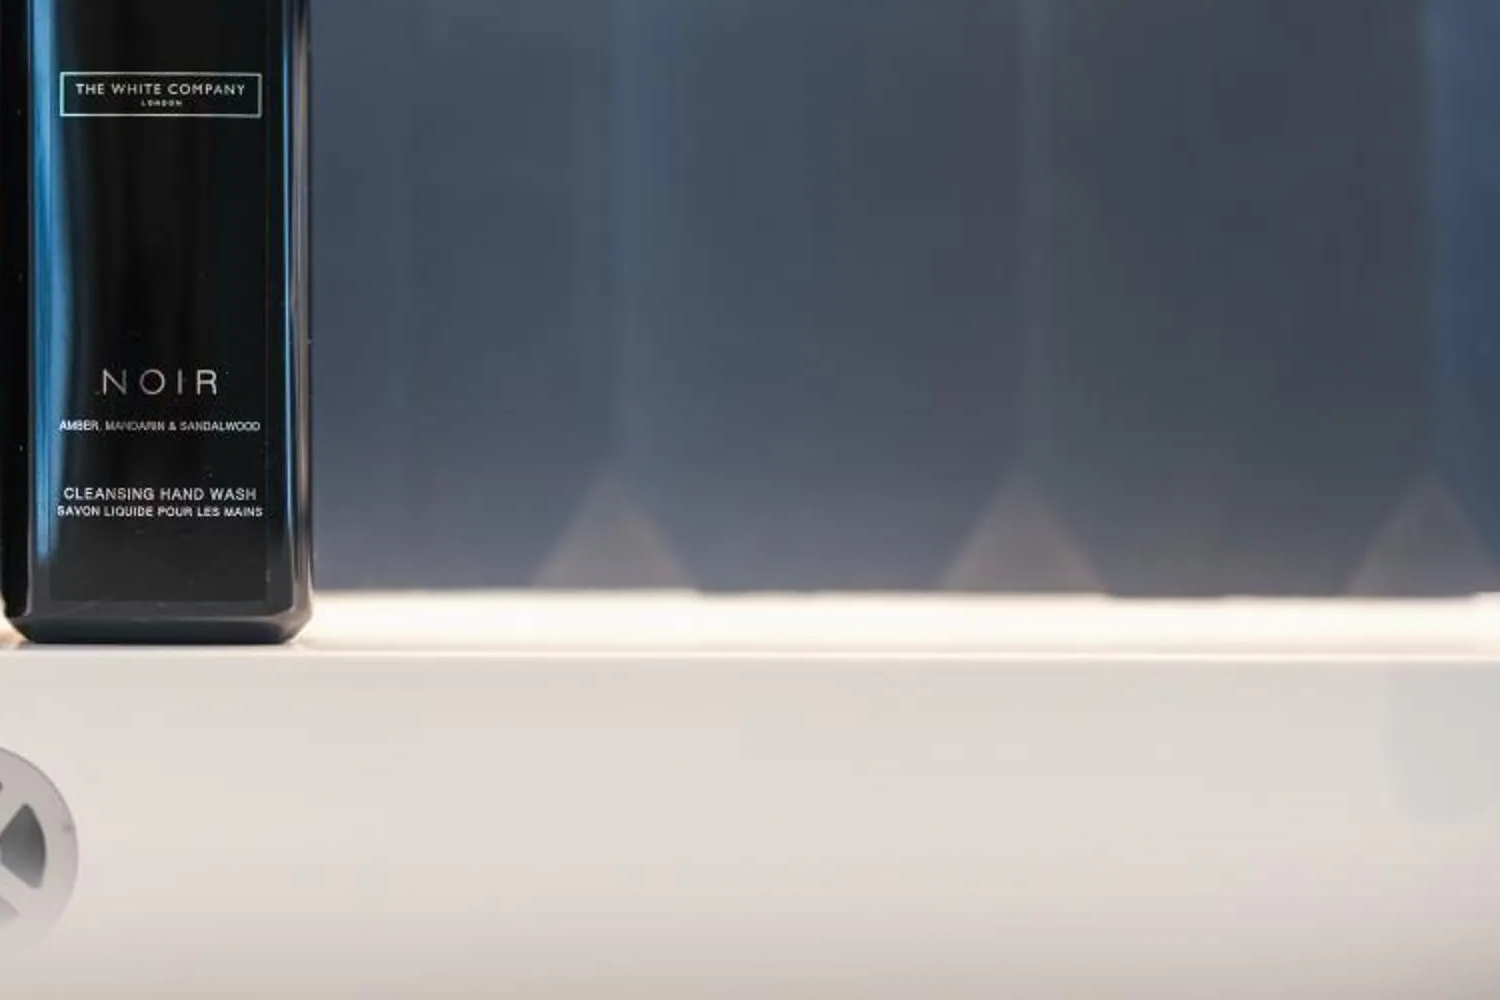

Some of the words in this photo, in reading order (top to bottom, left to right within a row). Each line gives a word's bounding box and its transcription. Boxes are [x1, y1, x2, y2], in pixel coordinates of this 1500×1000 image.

[75, 83, 104, 95] THE
[110, 83, 161, 95] WHITE
[168, 83, 245, 95] COMPANY
[102, 369, 217, 396] NOIR
[105, 421, 165, 431] MANDARIN
[169, 421, 176, 431] &
[180, 421, 260, 431] SANDALWOOD
[64, 488, 154, 500] CLEANSING
[160, 488, 204, 500] HAND
[210, 488, 256, 500] WASH
[58, 506, 100, 517] SAVON
[104, 506, 153, 517] LIQUIDE
[158, 506, 192, 517] POUR
[197, 506, 220, 517] LES
[224, 506, 263, 517] MAINS
